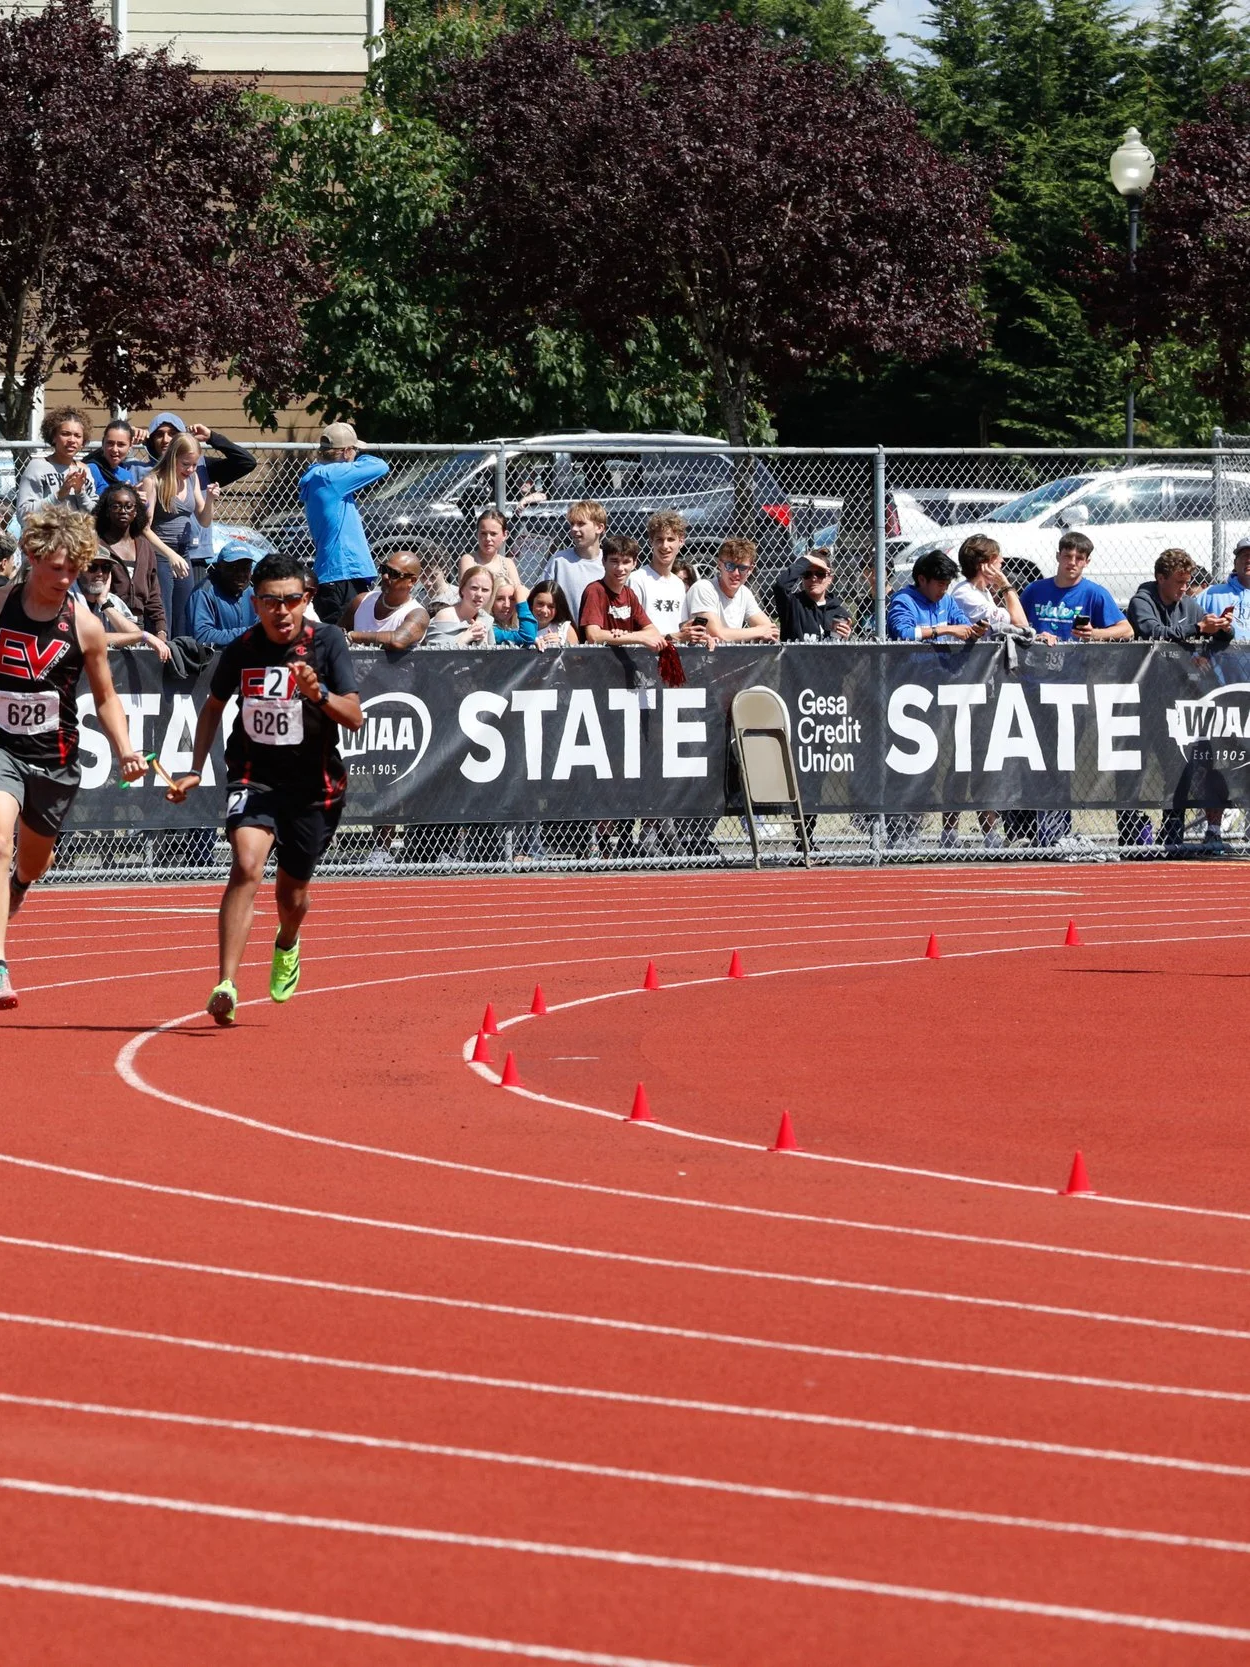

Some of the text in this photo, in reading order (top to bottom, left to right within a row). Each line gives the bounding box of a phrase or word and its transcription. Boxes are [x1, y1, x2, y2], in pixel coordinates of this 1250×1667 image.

[268, 669, 283, 697] 2
[8, 703, 47, 726] 628
[797, 688, 848, 716] Gesa
[253, 709, 289, 736] 626
[458, 687, 708, 783] STATE
[797, 716, 861, 744] Credit
[884, 682, 1142, 775] STATE
[798, 745, 855, 773] Union
[228, 791, 244, 814] 2
